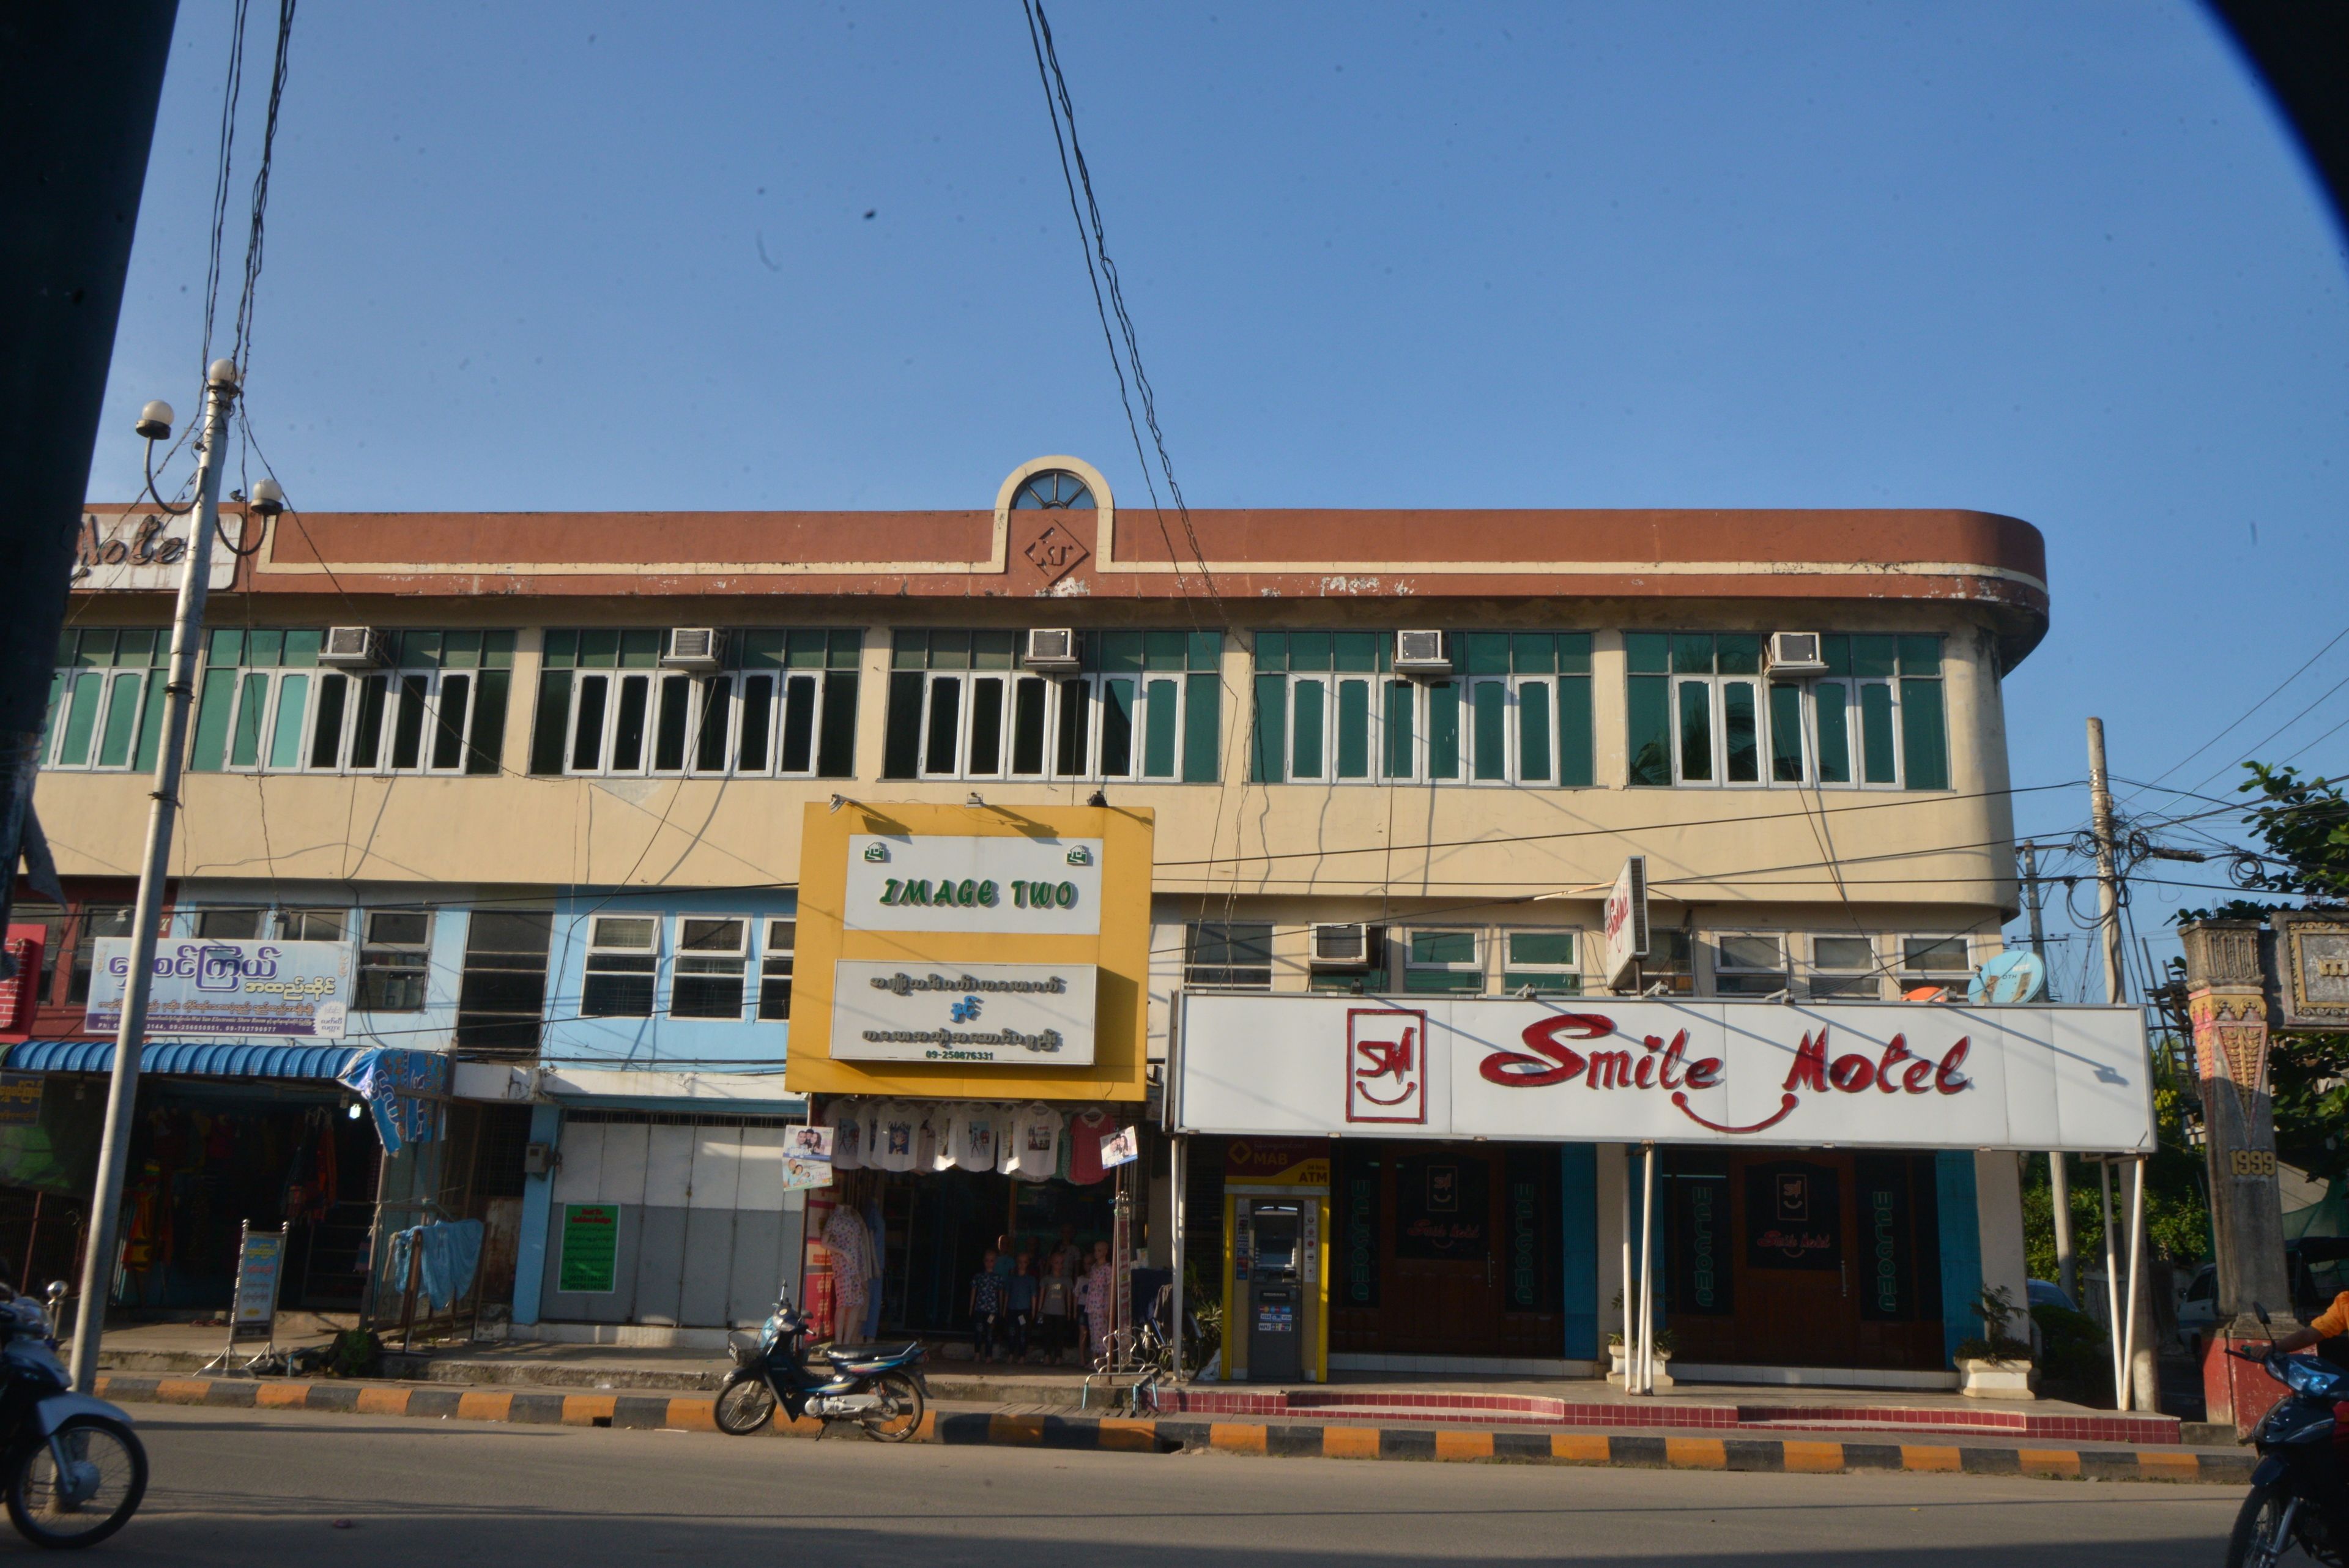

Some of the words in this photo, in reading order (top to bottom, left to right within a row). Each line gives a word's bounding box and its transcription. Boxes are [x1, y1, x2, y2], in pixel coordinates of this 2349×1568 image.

[76, 514, 188, 565] Mote
[879, 878, 995, 907] IMAGE
[1011, 880, 1074, 907] TWO
[926, 1050, 994, 1060] 09-250876331
[1479, 1013, 1723, 1091] Smile
[1783, 1024, 1972, 1094] Motel
[1253, 1152, 1289, 1165] MAB
[2229, 1150, 2277, 1176] 1999
[1299, 1172, 1327, 1183] ATM
